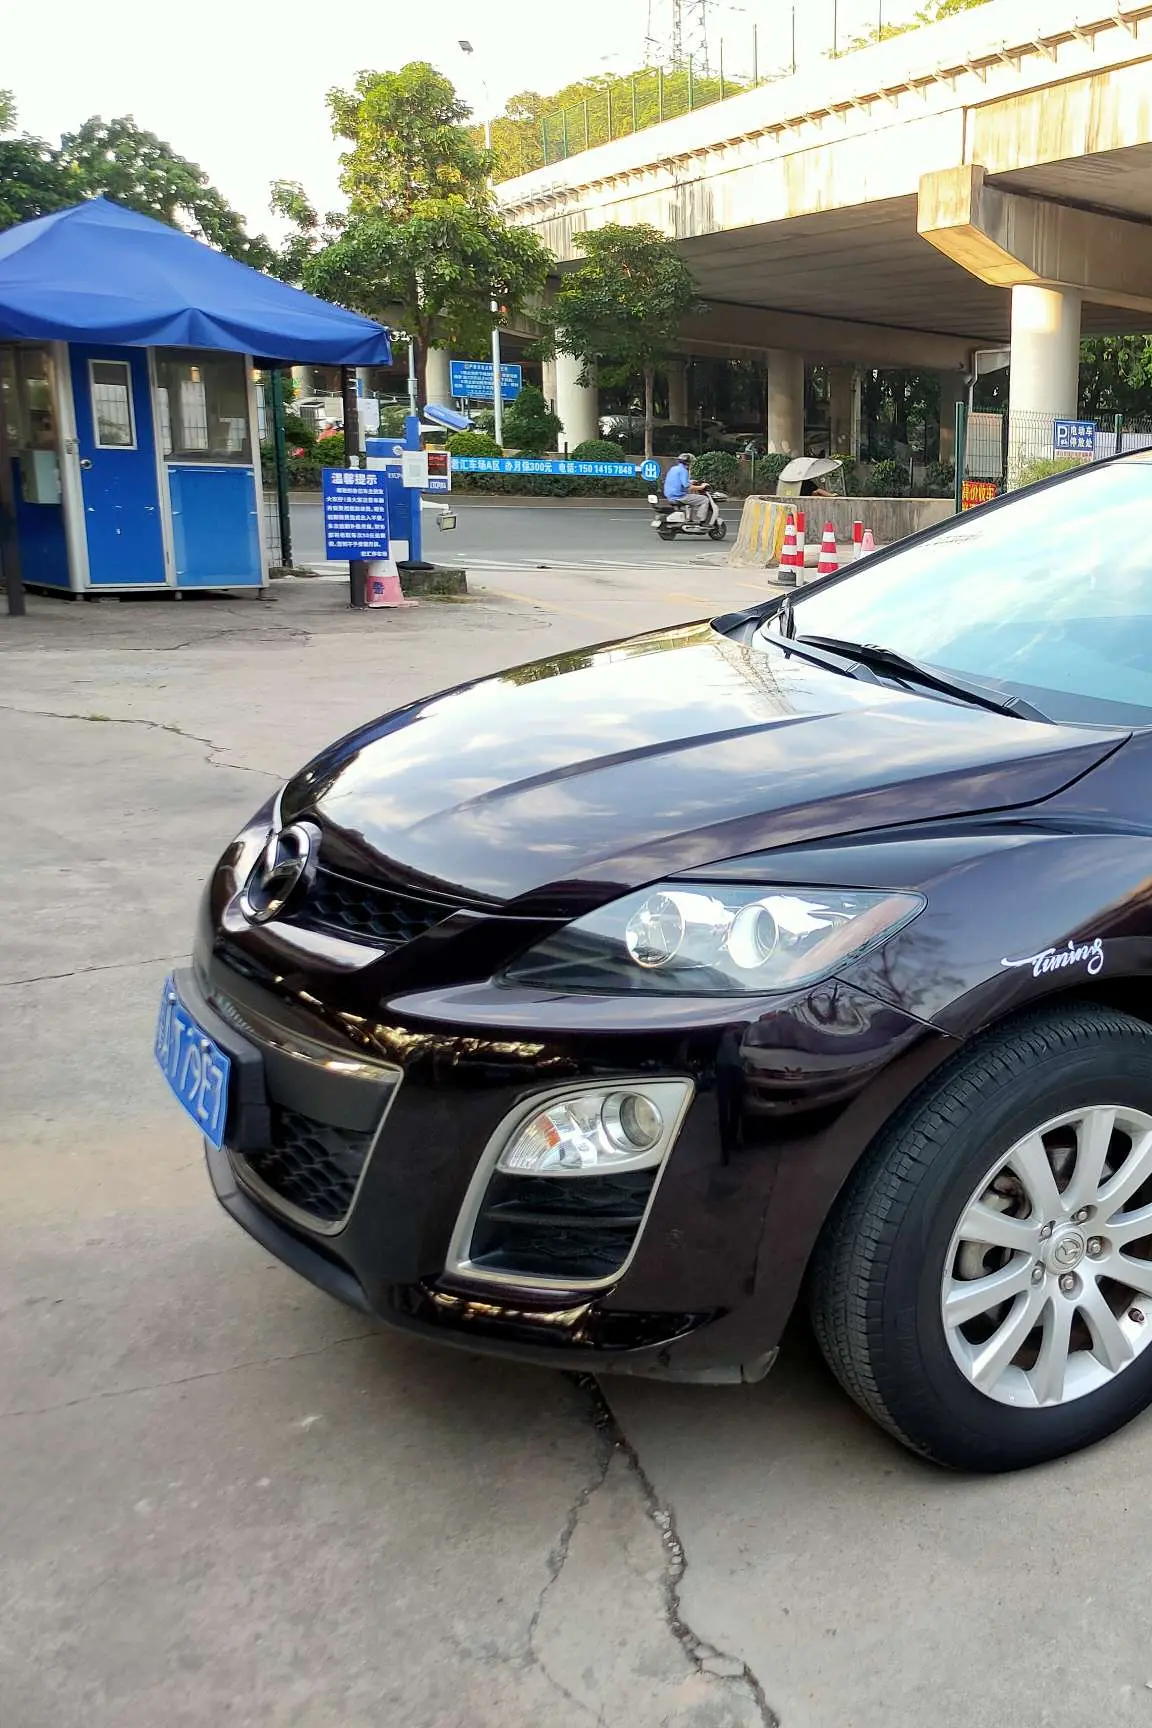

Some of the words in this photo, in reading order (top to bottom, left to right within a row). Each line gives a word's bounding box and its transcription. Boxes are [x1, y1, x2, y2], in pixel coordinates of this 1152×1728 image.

[1070, 425, 1093, 437] 电动车
[645, 463, 657, 478] 出
[331, 472, 378, 486] 温馨提示
[1000, 937, 1104, 978] Tuning
